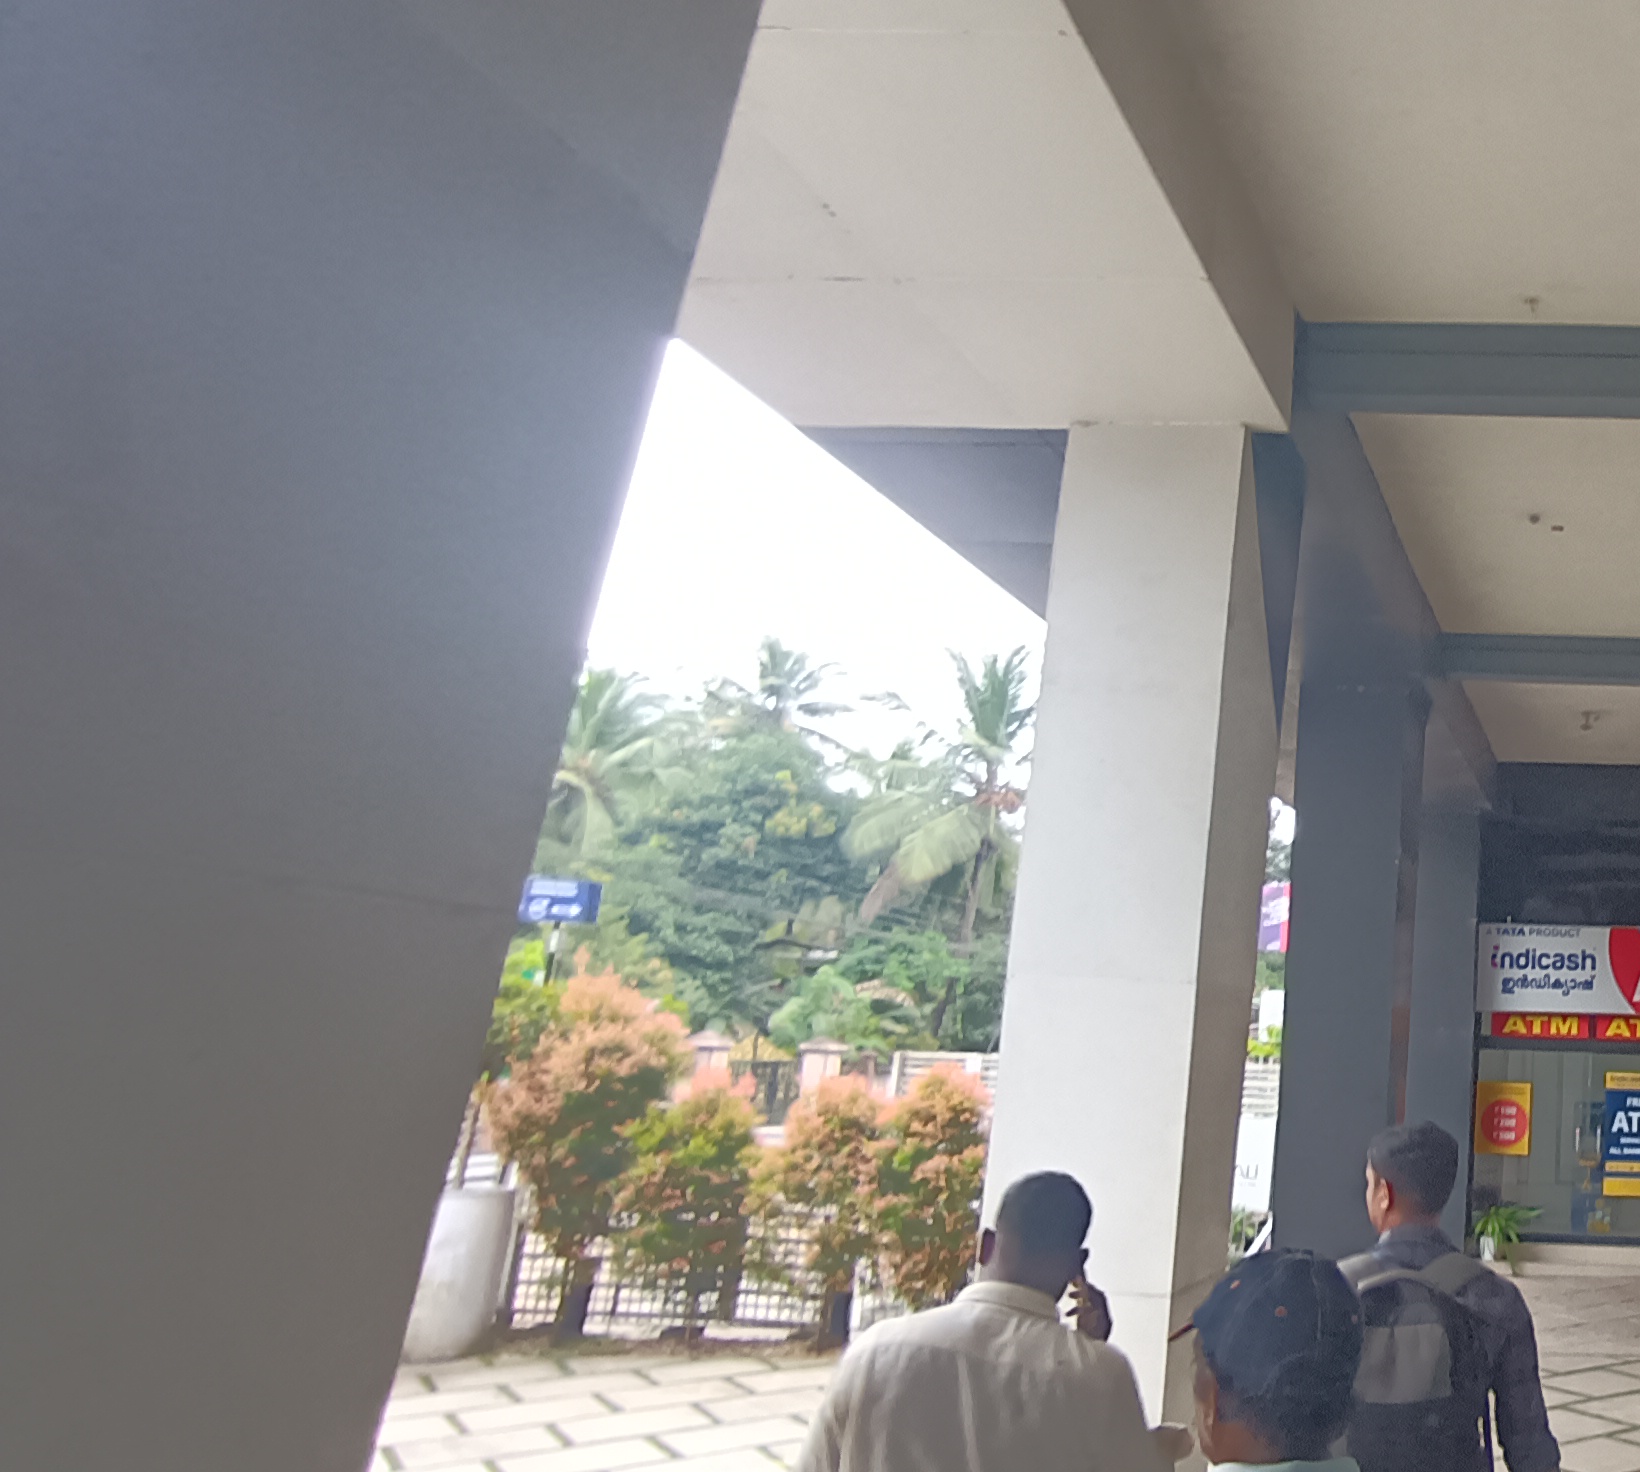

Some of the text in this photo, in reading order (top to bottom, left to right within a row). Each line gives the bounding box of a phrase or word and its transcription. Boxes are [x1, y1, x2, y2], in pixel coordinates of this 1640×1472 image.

[1495, 927, 1526, 937] TATA
[1528, 928, 1582, 938] PRODUCT
[1490, 944, 1597, 972] indicash
[1502, 1014, 1580, 1036] ATM
